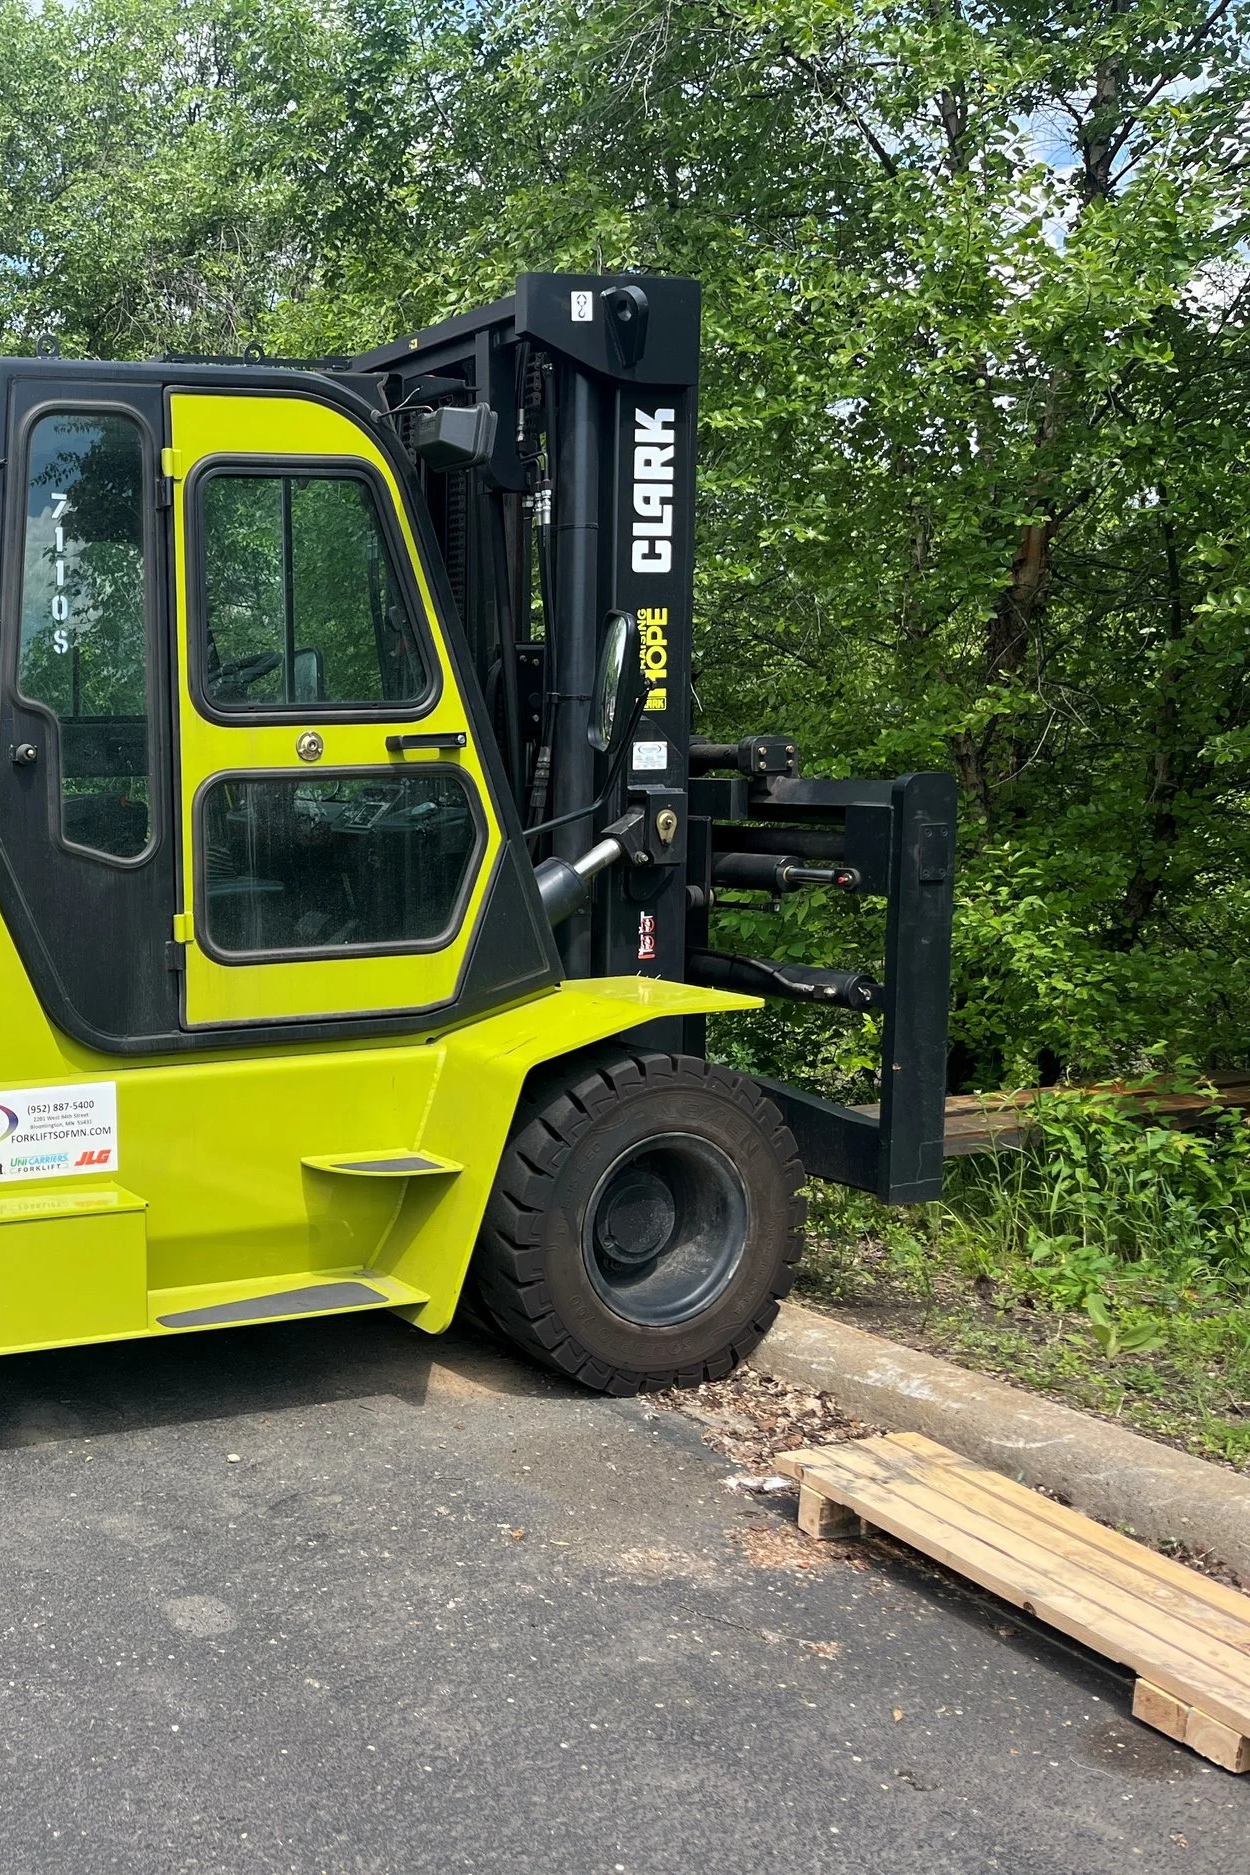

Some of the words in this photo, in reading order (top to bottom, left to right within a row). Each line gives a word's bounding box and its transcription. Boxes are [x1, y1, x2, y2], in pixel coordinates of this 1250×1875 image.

[631, 408, 675, 573] CLARK
[51, 492, 69, 654] 7110S
[27, 1104, 51, 1116] (952)
[53, 1100, 94, 1112] 887-5400
[11, 1126, 111, 1143] FORKLIFTSOFMN.COM
[74, 1149, 111, 1167] JLG
[18, 1163, 61, 1173] FORKLIFT
